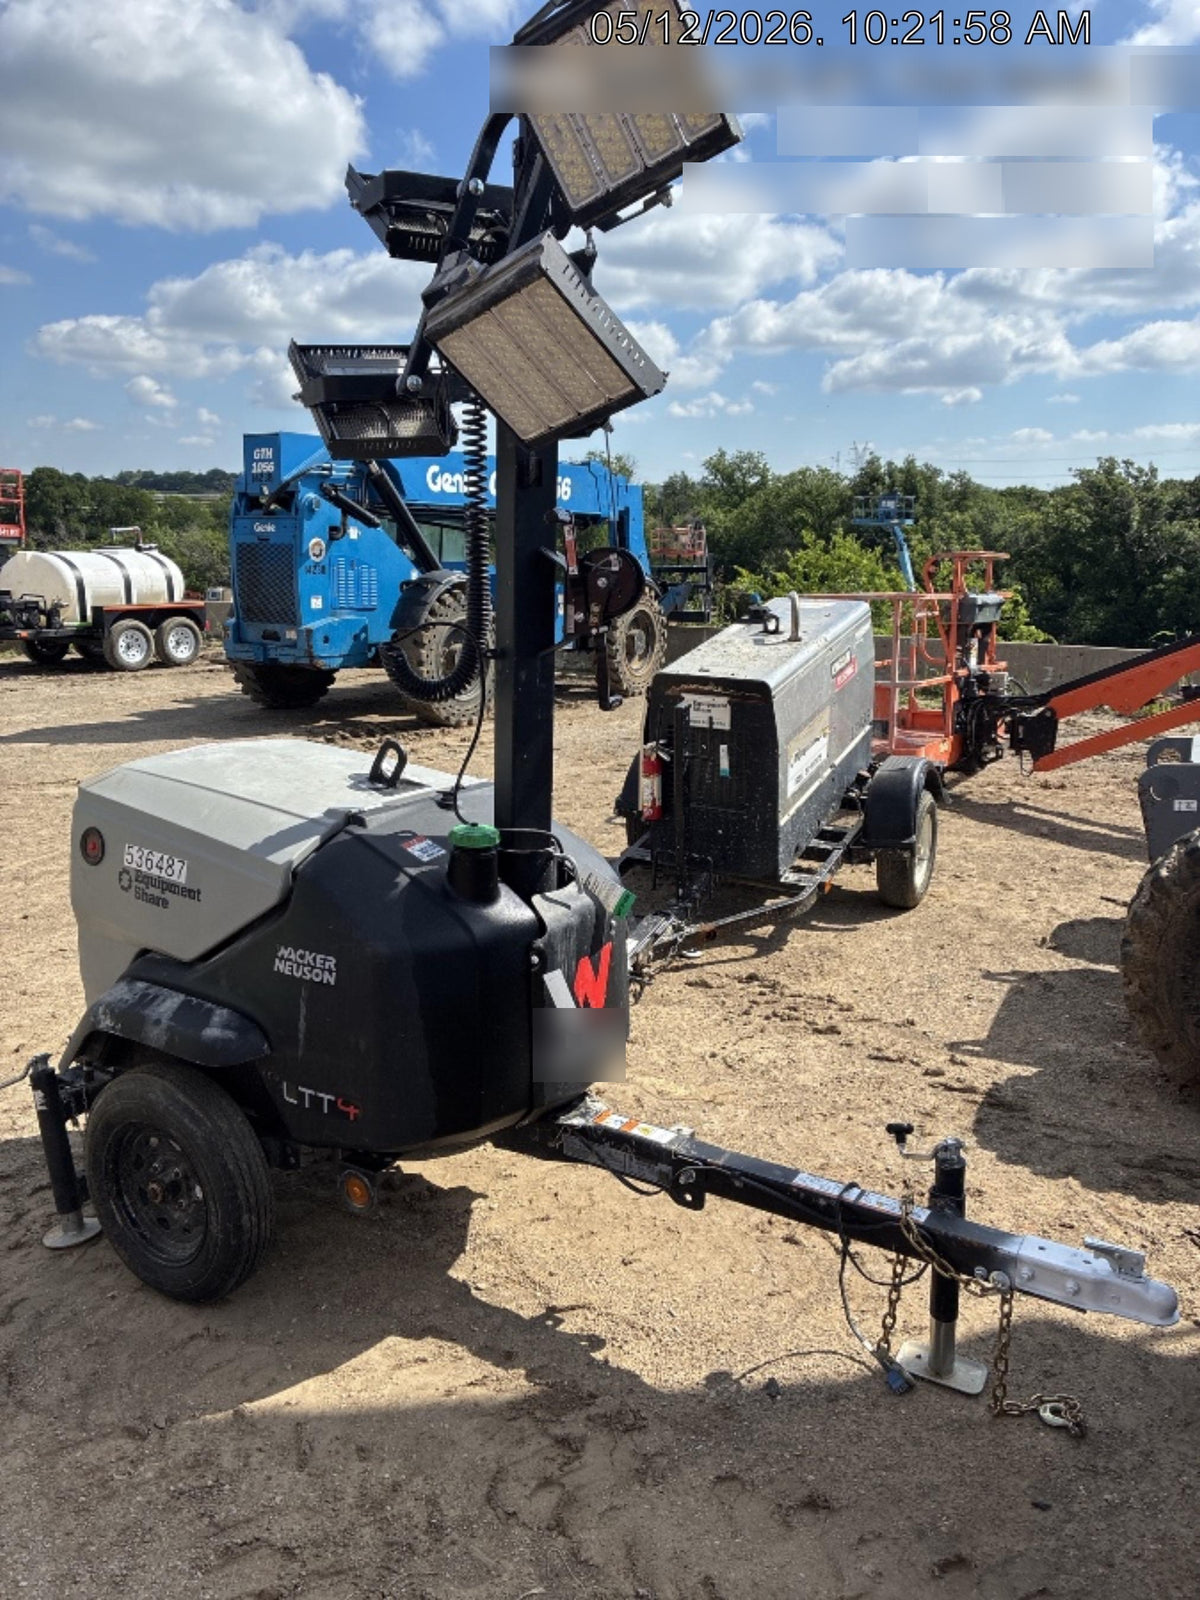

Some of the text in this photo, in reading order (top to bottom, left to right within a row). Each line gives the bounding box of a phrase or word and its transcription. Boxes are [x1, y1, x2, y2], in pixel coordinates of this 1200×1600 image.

[251, 461, 275, 474] 1056
[125, 845, 186, 881] 536487
[134, 868, 202, 903] Equipment
[134, 885, 170, 909] Share
[273, 957, 337, 986] NEUSON
[282, 1081, 359, 1121] LTT4
